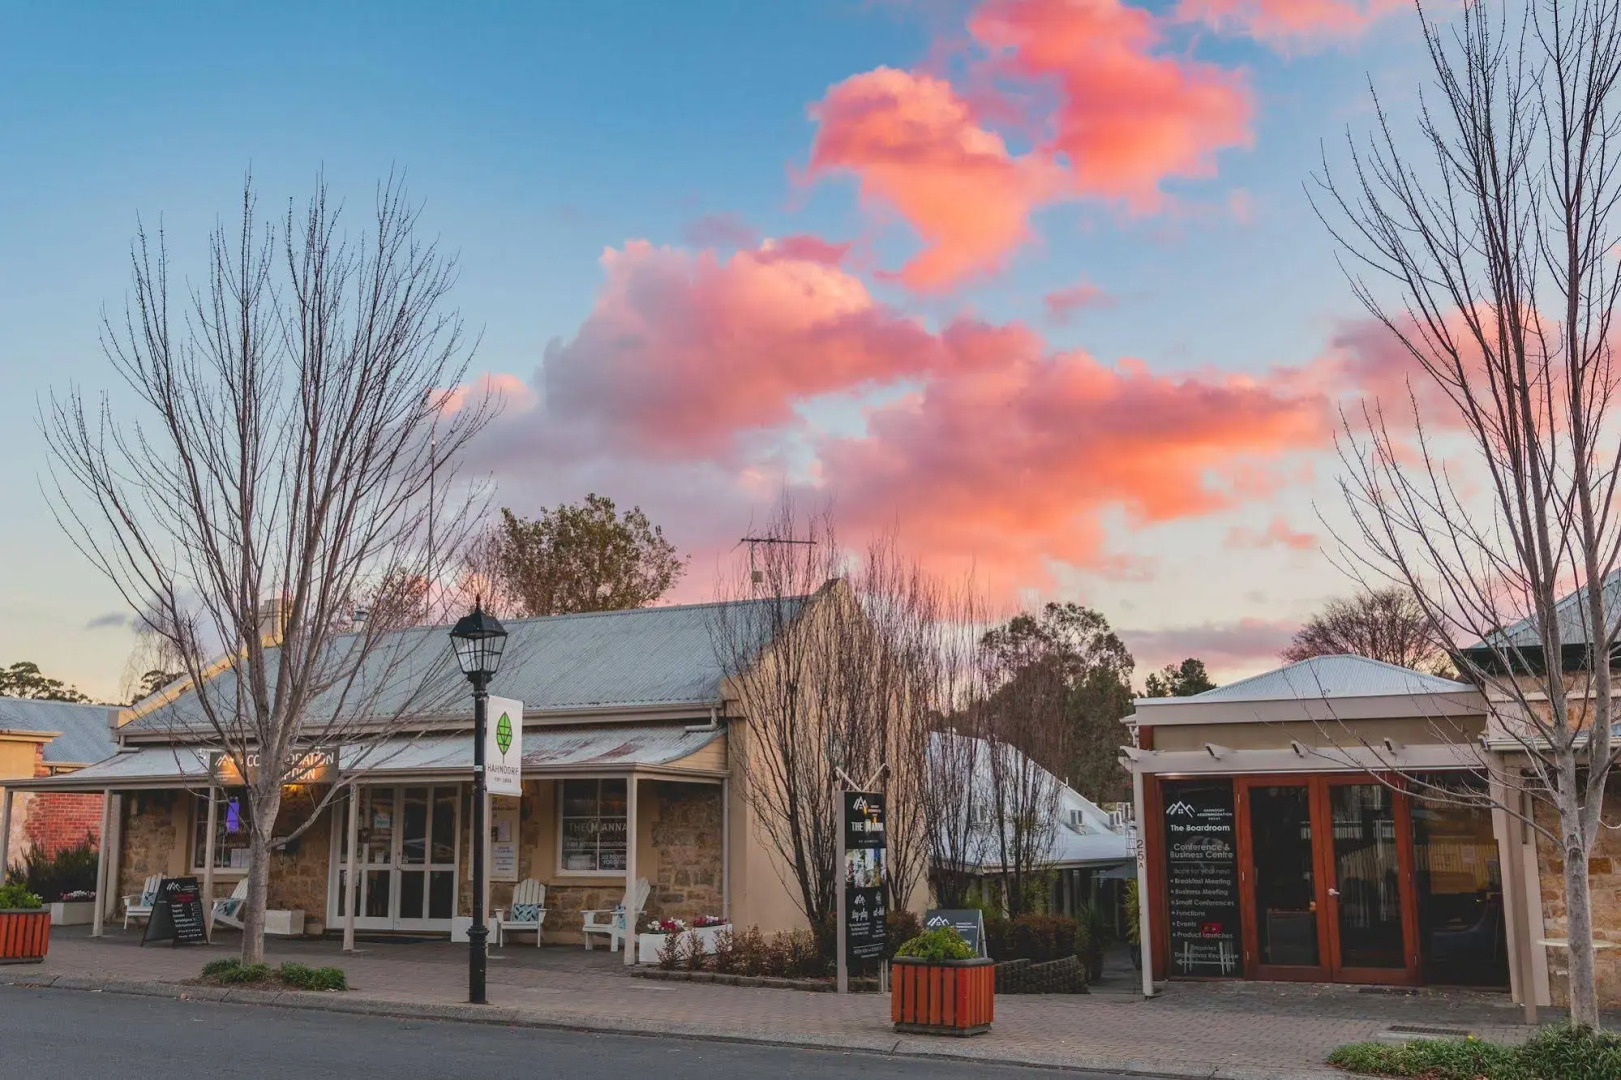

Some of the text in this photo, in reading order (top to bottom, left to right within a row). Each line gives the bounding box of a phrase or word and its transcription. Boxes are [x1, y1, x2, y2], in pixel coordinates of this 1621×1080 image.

[487, 763, 519, 775] HAHNDORF
[569, 822, 585, 832] THE
[851, 821, 864, 832] THE
[1170, 824, 1231, 832] The Boardroom
[1173, 842, 1230, 851] Conference &
[1169, 850, 1234, 859] Business Centre
[1205, 878, 1231, 886] Meeting
[1202, 888, 1228, 896] Meeting
[1194, 899, 1235, 907] Conferences
